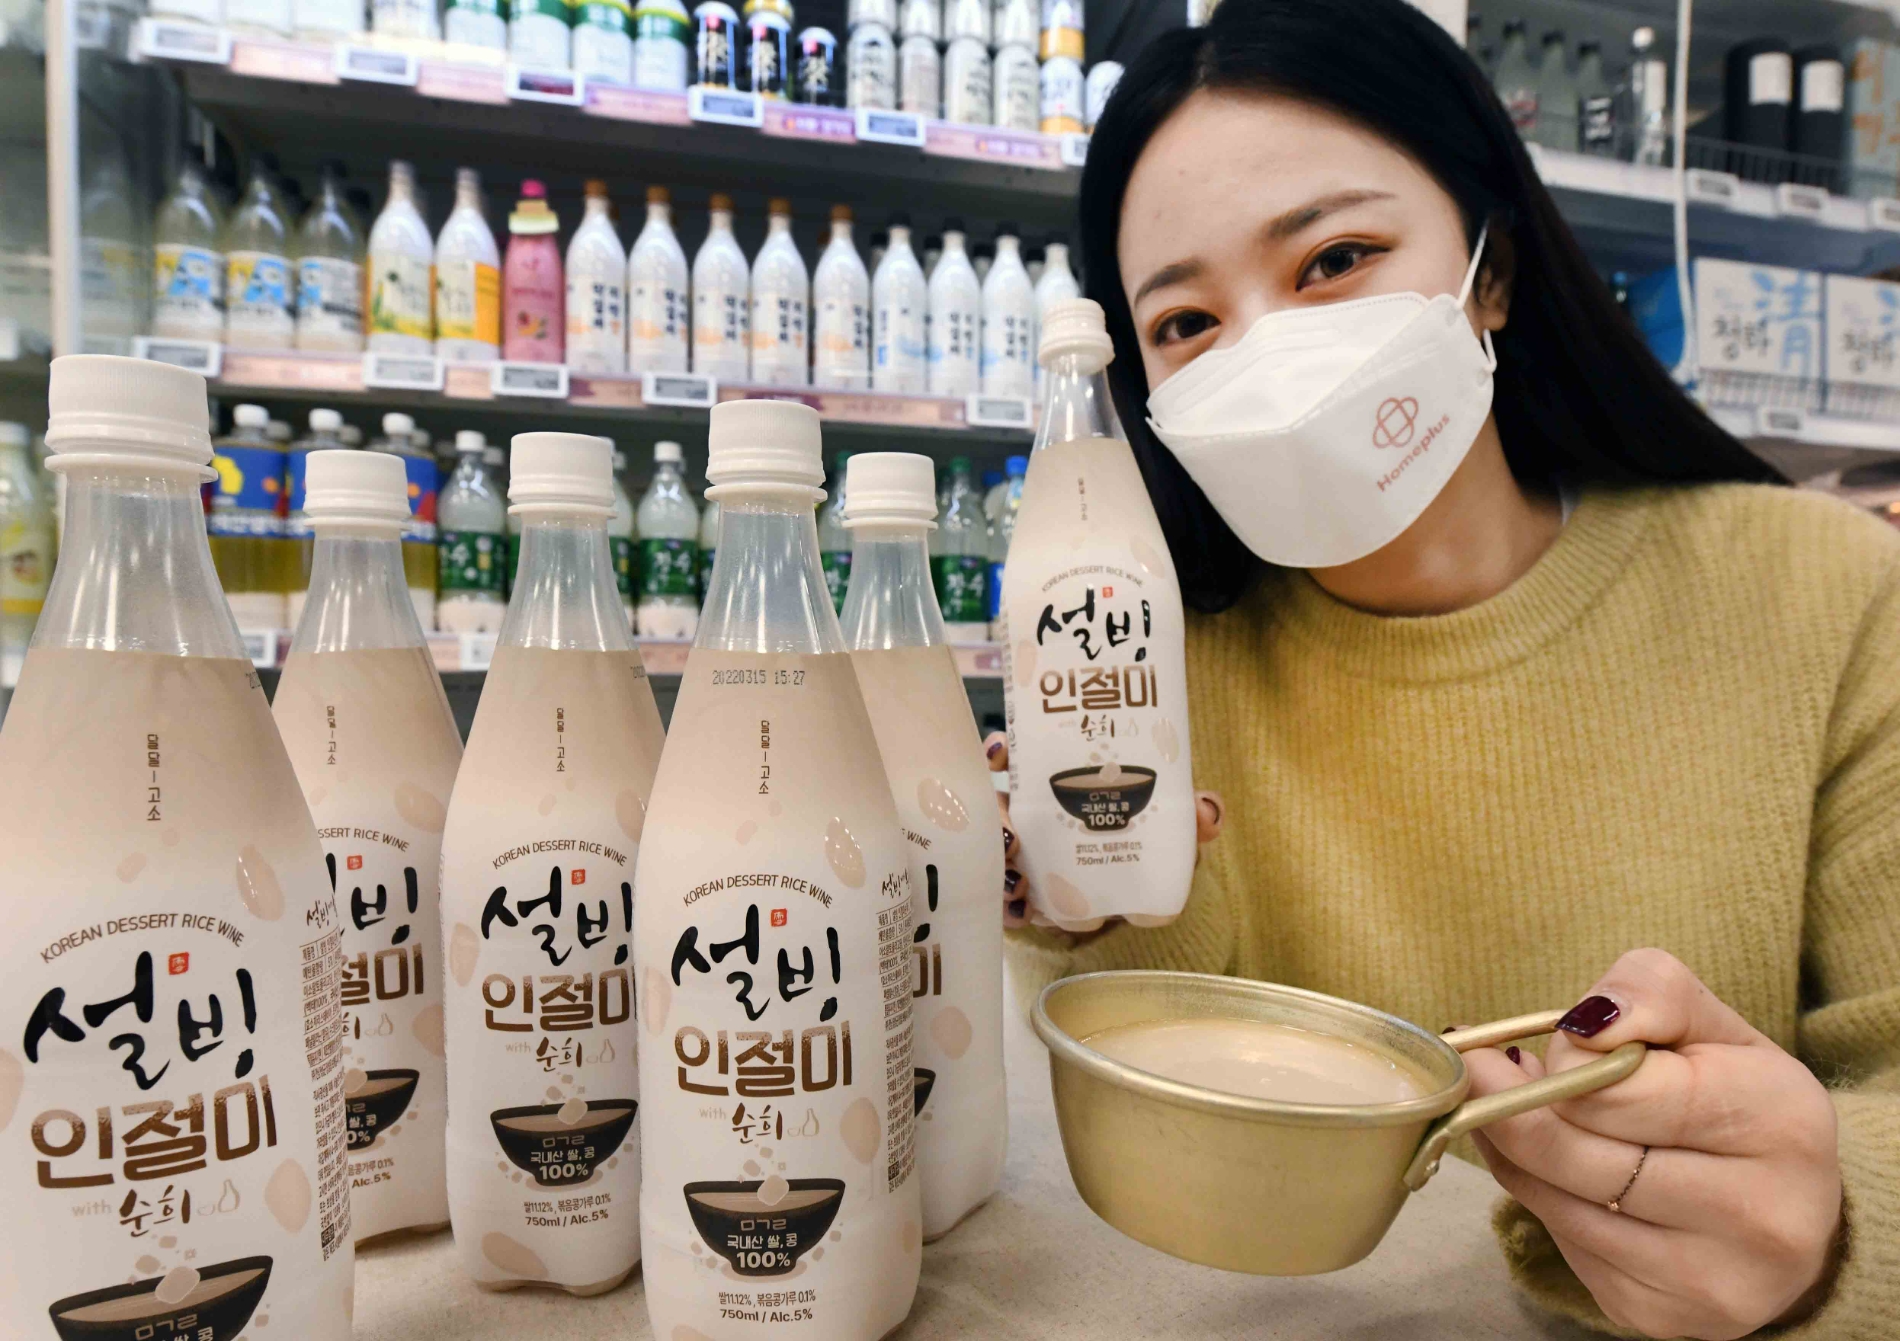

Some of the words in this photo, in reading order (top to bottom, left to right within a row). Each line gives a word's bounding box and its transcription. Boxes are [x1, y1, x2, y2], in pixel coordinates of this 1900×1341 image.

[1376, 414, 1450, 492] Homeplus
[1041, 572, 1070, 593] KOREAN
[1070, 565, 1104, 577] DESSERT
[1105, 566, 1124, 578] RICE
[1126, 572, 1144, 588] WINE
[1037, 583, 1151, 662] 설빙
[711, 669, 767, 686] 20220315
[774, 670, 806, 686] 15:27
[1039, 665, 1158, 714] 인절미
[1081, 803, 1107, 813] 국내산
[1088, 814, 1126, 826] 100%
[317, 827, 351, 839] SSERT
[353, 828, 379, 842] RICE
[382, 830, 410, 853] WINE
[907, 831, 932, 850] WINE
[492, 844, 530, 870] KOREAN
[532, 840, 577, 853] DESSERT
[579, 841, 601, 855] RICE
[603, 845, 627, 867] WINE
[1076, 856, 1104, 865] 750ml
[683, 879, 725, 908] KOREAN
[726, 874, 779, 889] DESSERT
[780, 877, 808, 893] RICE
[808, 885, 833, 909] WINE
[481, 866, 633, 966] 설빙
[40, 924, 102, 964] KOREAN
[107, 913, 179, 934] DESSERT
[182, 913, 216, 931] RICE
[217, 919, 245, 948] WINE
[671, 903, 841, 1021] 설빙
[482, 965, 638, 1032] 인절미
[23, 951, 257, 1090] 설빙
[505, 1042, 531, 1053] with
[536, 1037, 582, 1072] 순희
[674, 1020, 853, 1098] 인절미
[31, 1074, 277, 1189] 인절미
[366, 1114, 377, 1127] 콩
[699, 1107, 727, 1120] with
[731, 1102, 783, 1144] 순희
[346, 1130, 371, 1144] 0%
[377, 1158, 394, 1171] 0.1%
[530, 1151, 564, 1164] 국내산
[584, 1146, 595, 1159] 콩
[351, 1172, 391, 1188] Alc.5%
[539, 1162, 589, 1180] 100%
[72, 1199, 113, 1218] with
[118, 1184, 191, 1238] 순희
[558, 1197, 594, 1212] 볶음콩가루
[595, 1193, 612, 1206] 0.1%
[525, 1216, 560, 1228] 750ml
[570, 1209, 609, 1227] Alc.5%
[727, 1235, 764, 1250] 국내산
[785, 1233, 798, 1247] 콩
[736, 1251, 791, 1268] 100%
[757, 1291, 797, 1307] 볶음콩가루
[798, 1289, 816, 1303] 0.1%
[720, 1308, 759, 1322] 750ml
[770, 1308, 813, 1323] Alc.5%
